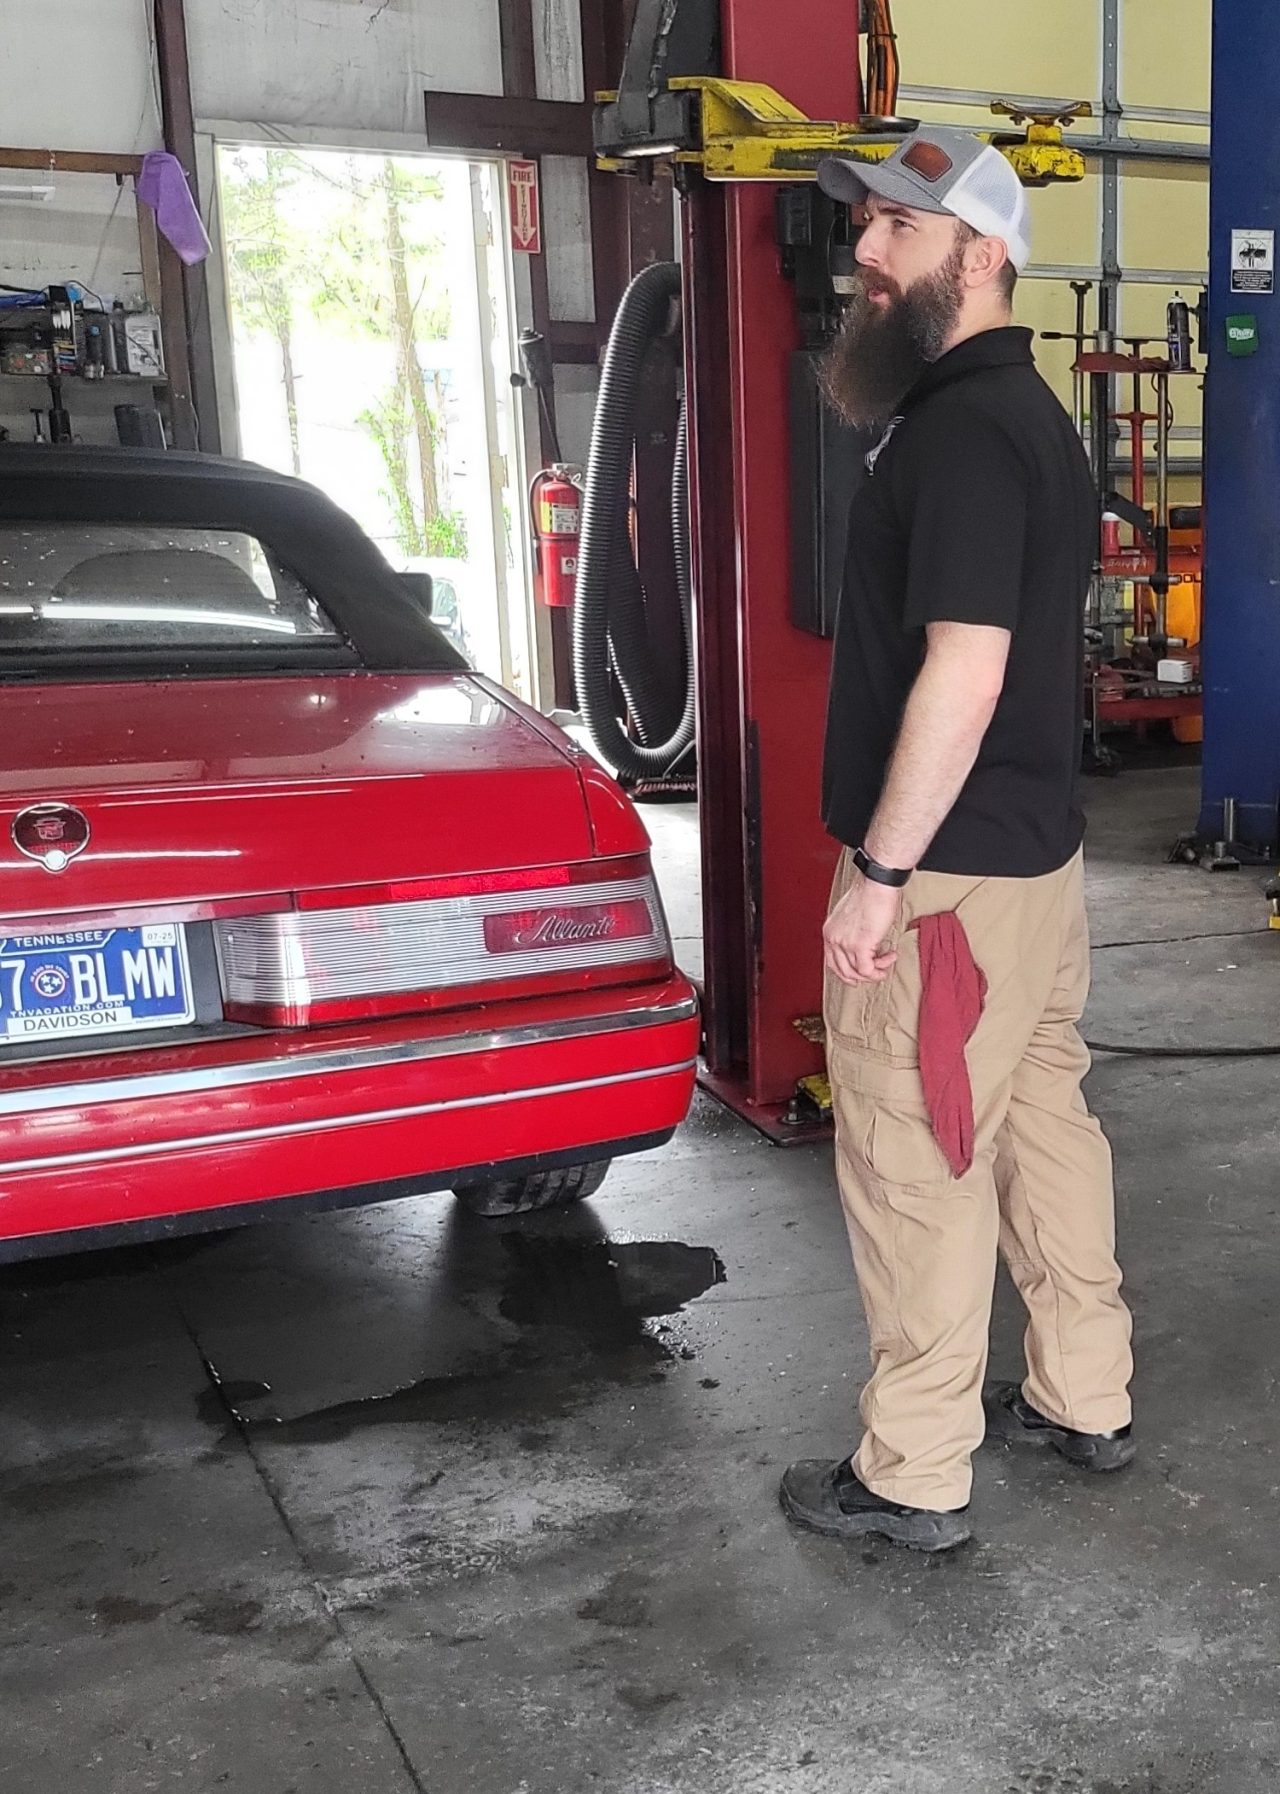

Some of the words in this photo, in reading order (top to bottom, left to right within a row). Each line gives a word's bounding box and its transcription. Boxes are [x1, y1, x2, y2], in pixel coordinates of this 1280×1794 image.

[512, 170, 532, 182] FIRE
[14, 931, 104, 948] TENNESSEE
[69, 947, 177, 1005] BLMW
[10, 1000, 124, 1018] TNVACATION.COM
[23, 1011, 118, 1032] DAVIDSON
